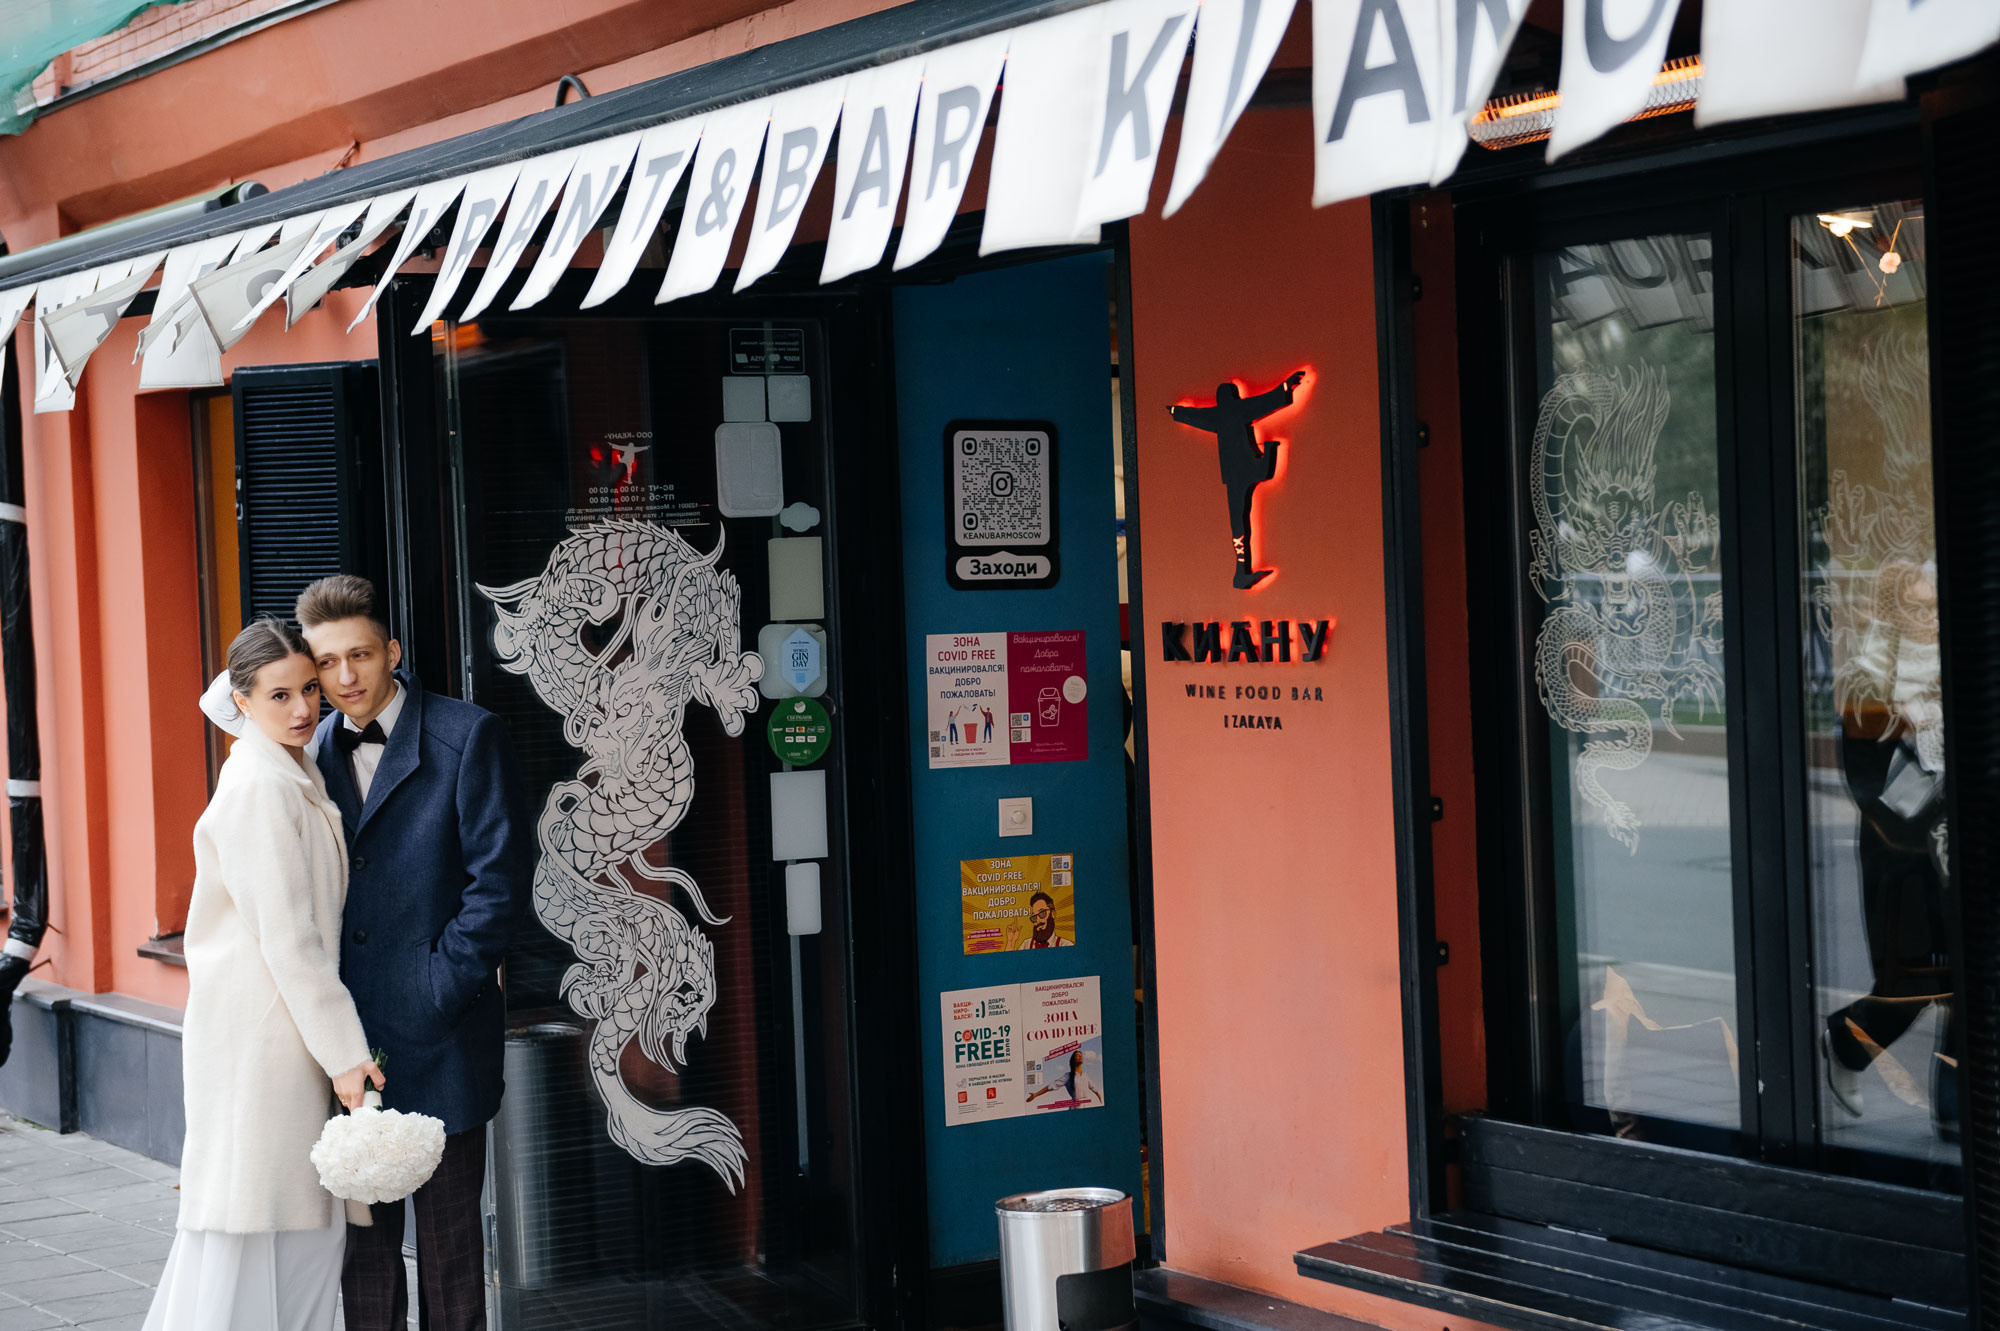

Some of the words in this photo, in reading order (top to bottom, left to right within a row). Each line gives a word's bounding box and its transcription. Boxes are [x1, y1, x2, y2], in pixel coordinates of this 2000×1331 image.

[970, 559, 1037, 576] Заходи
[954, 637, 980, 647] ЗОНА
[1013, 633, 1080, 644] Вакцинировался!
[1162, 620, 1329, 663] КИАНУ
[792, 652, 808, 660] GIN
[938, 650, 968, 661] COVID
[972, 650, 996, 660] FREE
[1034, 649, 1059, 659] Добро
[929, 664, 1005, 675] ВАКЦИНИРОВАЛСЯ!
[955, 678, 981, 687] ДОБРО
[940, 689, 996, 699] ПОЖАЛОВАТЬ!
[1186, 684, 1226, 699] WINE
[1236, 686, 1280, 700] FOOD
[1292, 687, 1323, 701] BAR
[990, 860, 1012, 869] ЗОНА
[977, 873, 1001, 883] COVID
[1003, 871, 1022, 881] FREE
[962, 882, 1041, 896] ВАКЦИНИРОВАЛСЯ!
[988, 897, 1016, 907] ДОБРО
[973, 908, 1031, 920] ПОЖАЛОВАТЬ!
[1044, 1010, 1078, 1023] ЗОНА
[1027, 1028, 1065, 1041] COVID
[1068, 1024, 1097, 1037] FREE
[955, 1039, 1005, 1063] FREE
